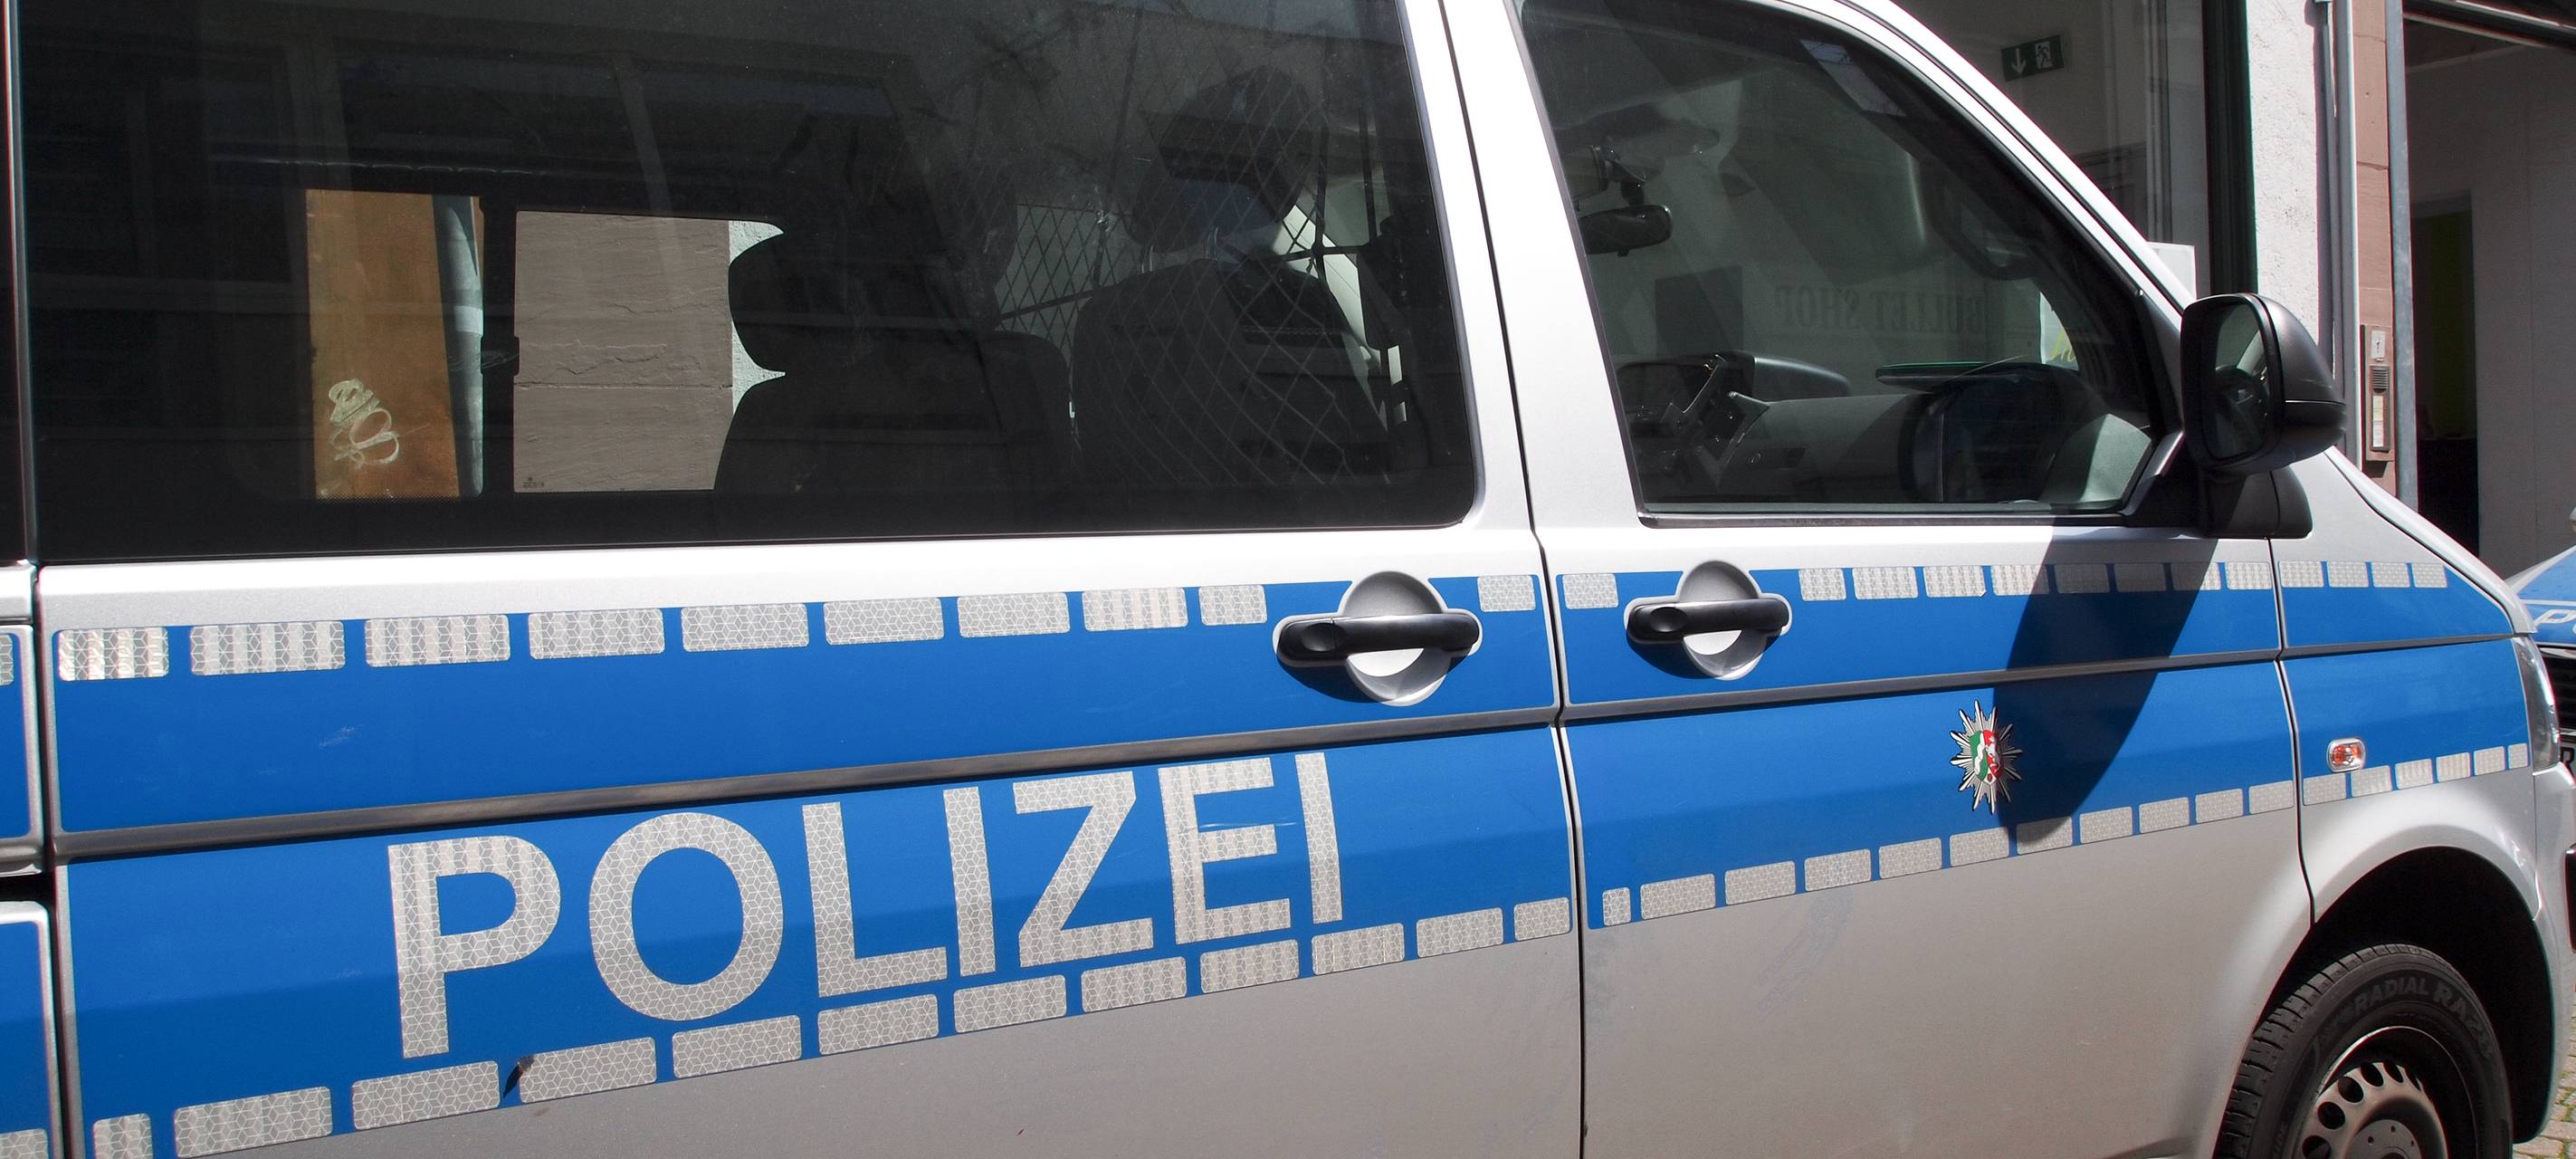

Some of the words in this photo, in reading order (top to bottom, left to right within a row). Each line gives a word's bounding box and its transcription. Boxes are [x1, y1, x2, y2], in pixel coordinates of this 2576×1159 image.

[2533, 608, 2576, 635] P
[387, 752, 1343, 1058] POLIZEI
[2354, 977, 2429, 1015] RADIAL
